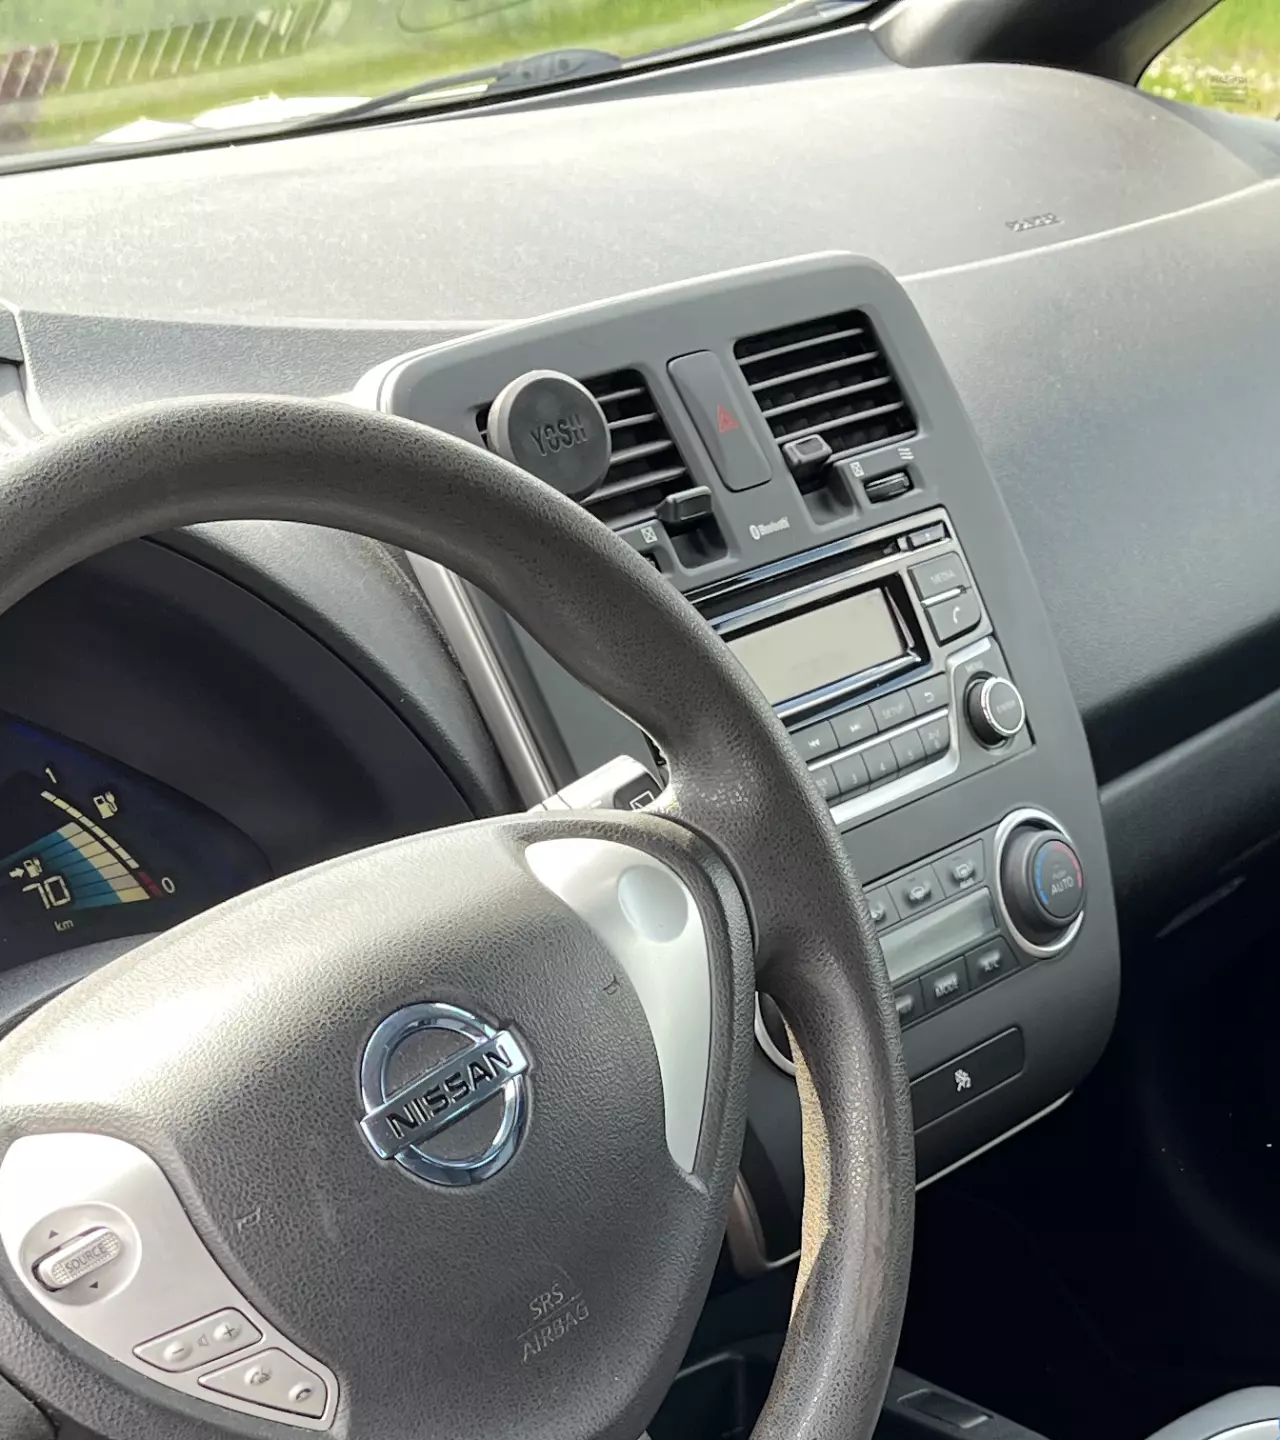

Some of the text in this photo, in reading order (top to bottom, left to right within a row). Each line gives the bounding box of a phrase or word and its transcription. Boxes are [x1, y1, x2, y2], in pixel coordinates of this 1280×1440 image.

[22, 875, 71, 909] 70
[161, 877, 176, 893] 0
[1051, 876, 1074, 895] AUTO
[54, 918, 74, 932] km
[385, 1044, 514, 1139] NISSAN
[65, 1241, 108, 1274] SOURCE
[529, 1283, 564, 1320] SRS
[522, 1300, 589, 1363] AIRBAG
